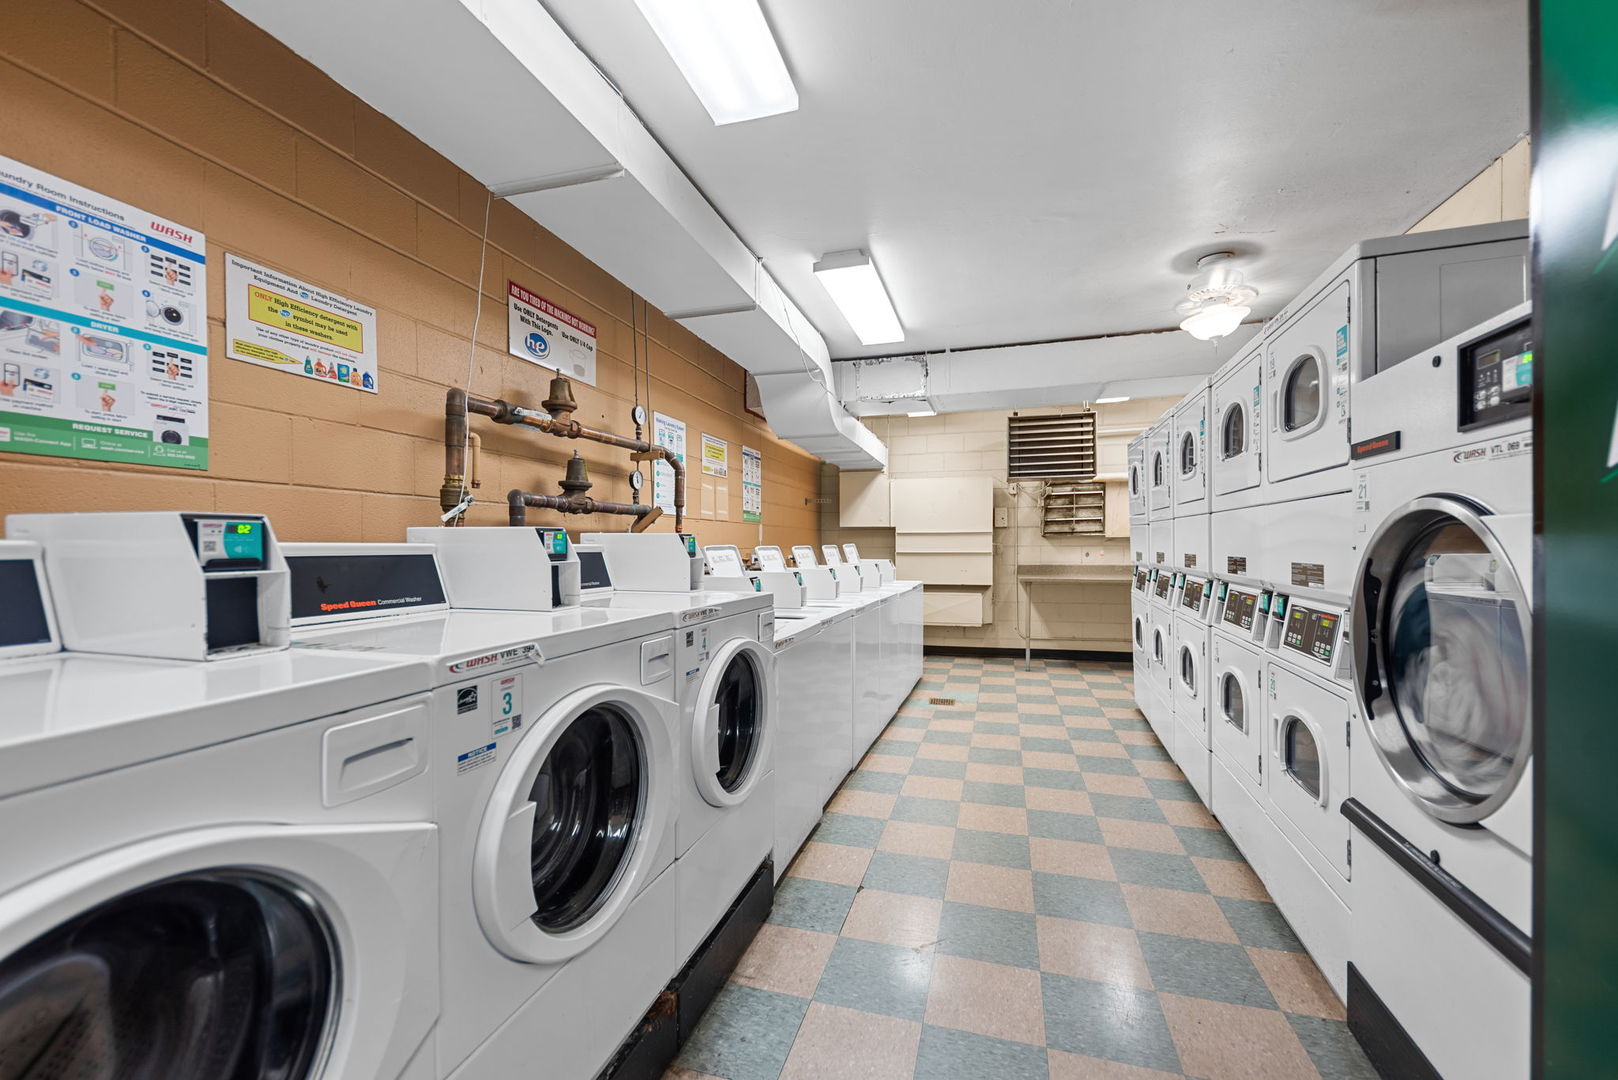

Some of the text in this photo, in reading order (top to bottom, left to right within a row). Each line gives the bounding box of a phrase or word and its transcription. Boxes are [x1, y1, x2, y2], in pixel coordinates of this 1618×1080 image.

[36, 183, 67, 200] Room
[69, 195, 125, 221] Instructions
[55, 205, 147, 242] FRONT LOAD WASHER
[150, 221, 193, 243] WASH
[231, 259, 373, 316] Important Information About High Efficiency Laundry
[253, 275, 286, 290] Equipment
[286, 287, 298, 295] And
[311, 296, 333, 308] Laundry
[333, 304, 357, 316] Detergent
[254, 291, 358, 331] ONLY High Efficiency detergent with
[267, 306, 278, 314] the
[292, 314, 314, 326] symbol
[314, 321, 327, 330] may
[335, 328, 348, 337] used
[513, 303, 559, 330] Use ONLY Detergents
[90, 320, 120, 333] DRYER
[292, 323, 309, 333] these
[309, 329, 334, 340] washers.
[519, 315, 553, 337] With This Logo.
[561, 331, 569, 340] Use
[569, 335, 579, 346] ONLY
[585, 343, 593, 352] Cup
[72, 423, 149, 439] REQUEST SERVICE
[1464, 447, 1487, 460] WASH
[1358, 482, 1367, 499] 21
[320, 601, 350, 611] Speed
[349, 599, 377, 608] Queen
[377, 598, 405, 606] Commercial
[465, 653, 498, 668] WASH
[500, 648, 518, 659] VWE
[502, 691, 512, 715] 3
